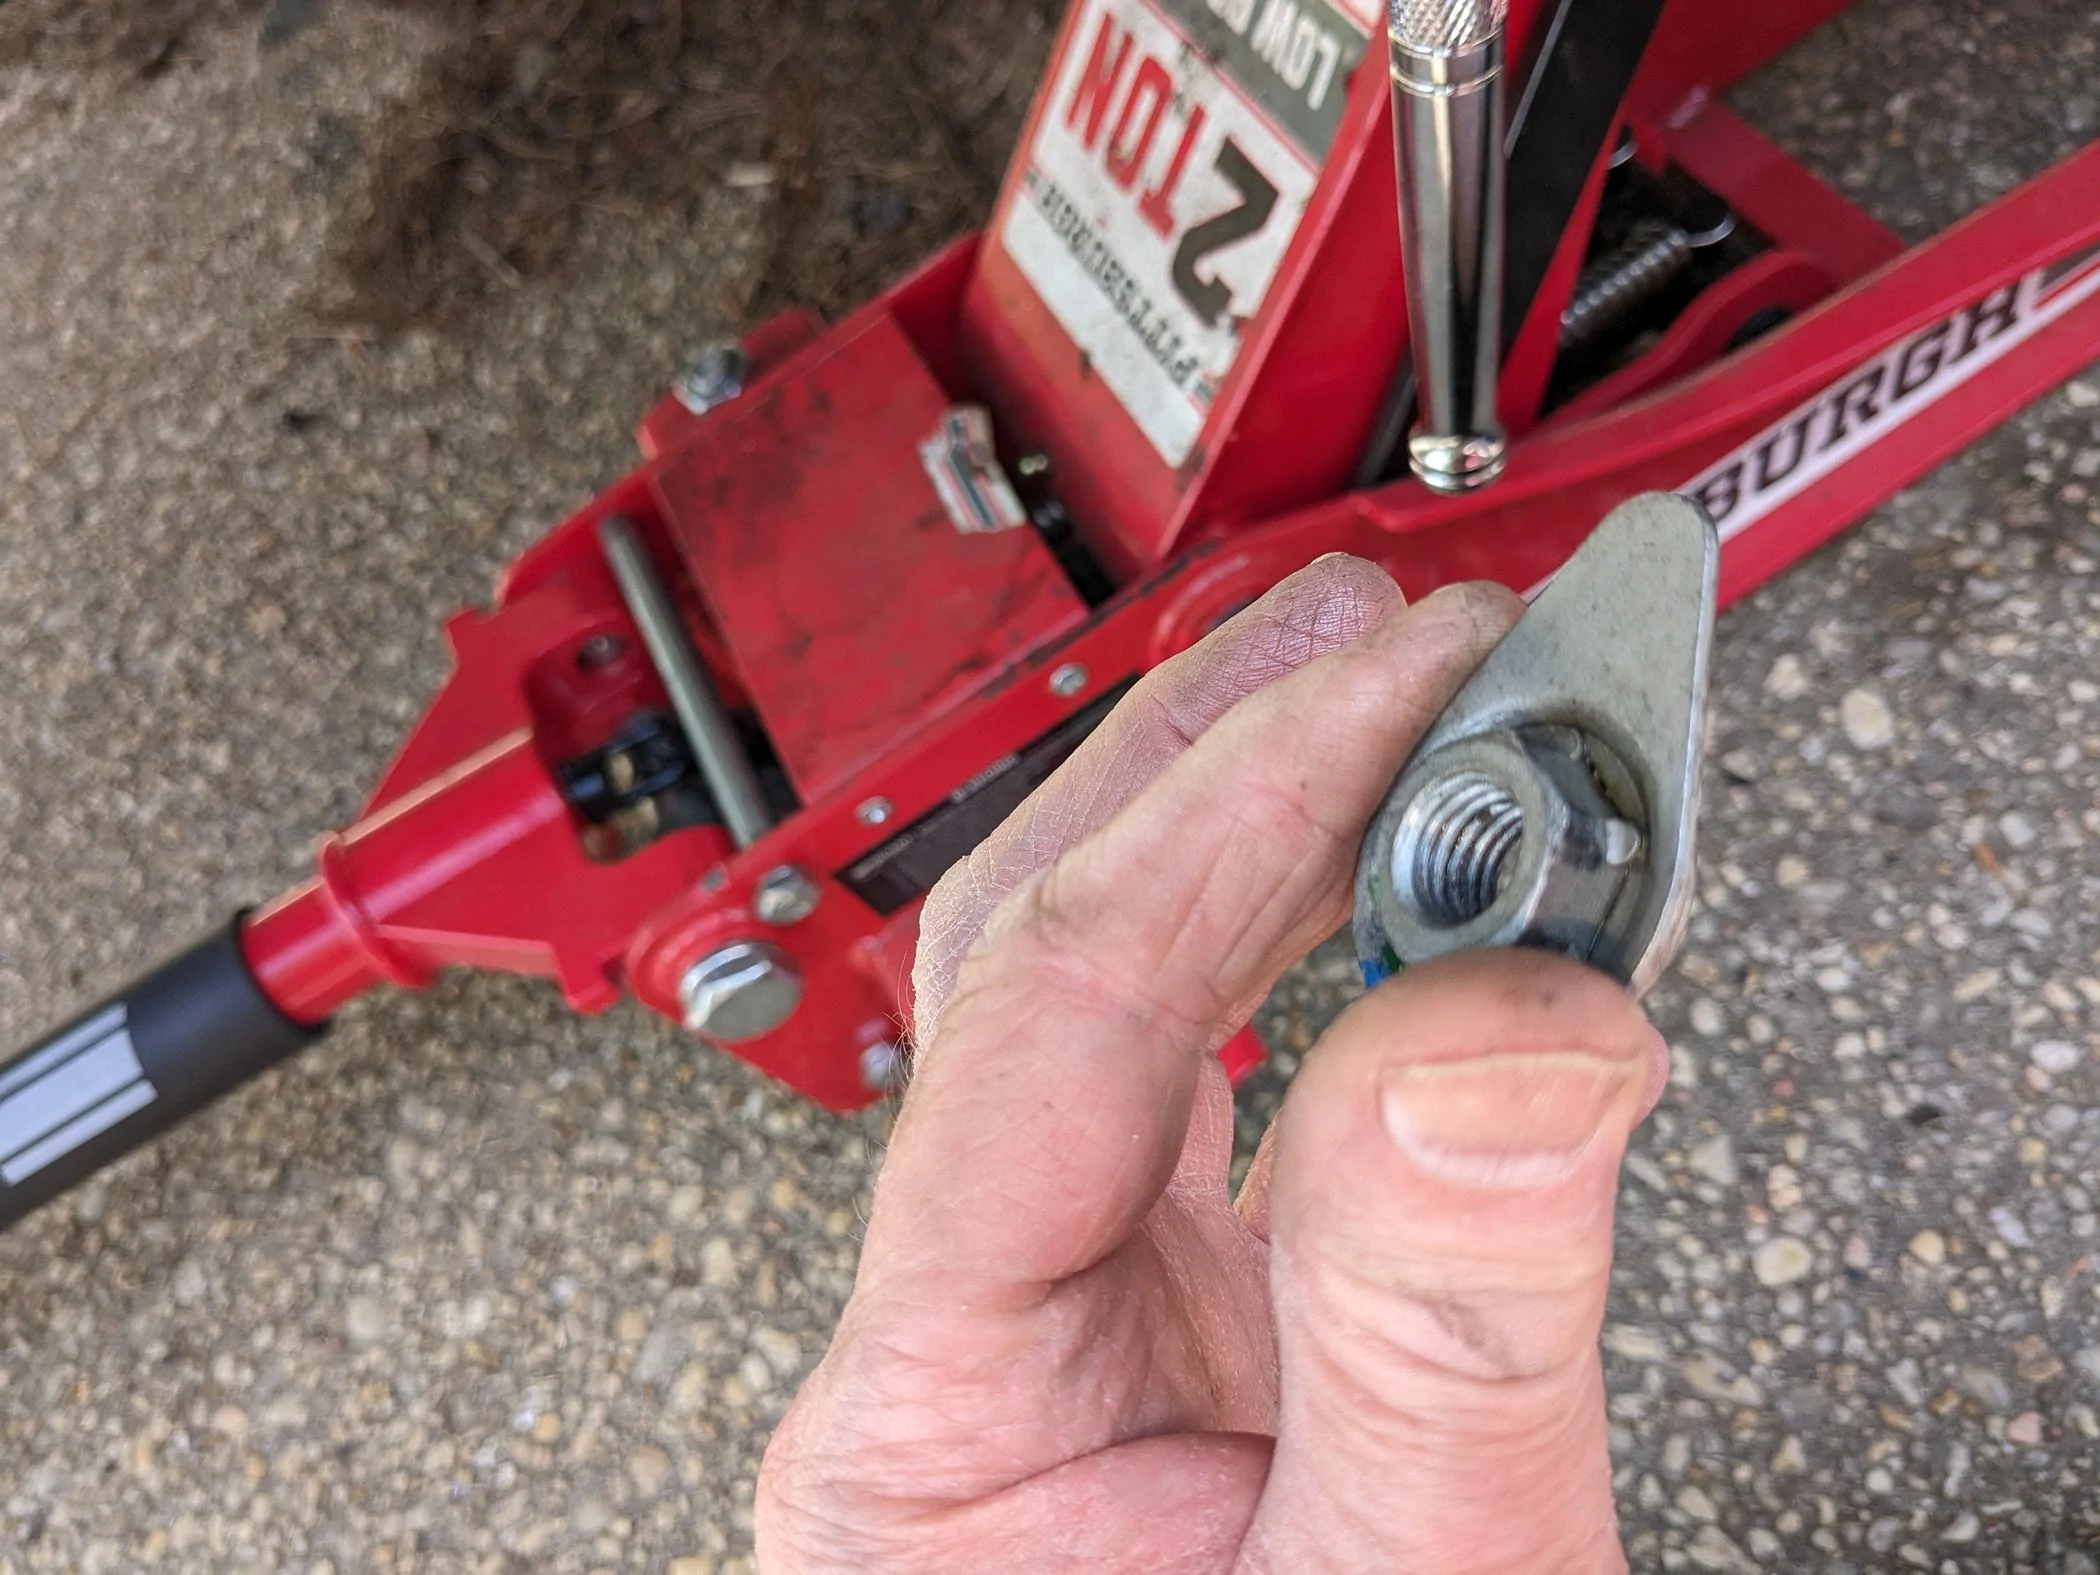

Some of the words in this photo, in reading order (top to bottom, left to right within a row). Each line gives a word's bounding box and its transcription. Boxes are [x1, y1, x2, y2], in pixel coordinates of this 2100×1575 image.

[1065, 11, 1207, 242] TON
[1252, 0, 1341, 110] LOW
[1172, 136, 1281, 329] 2
